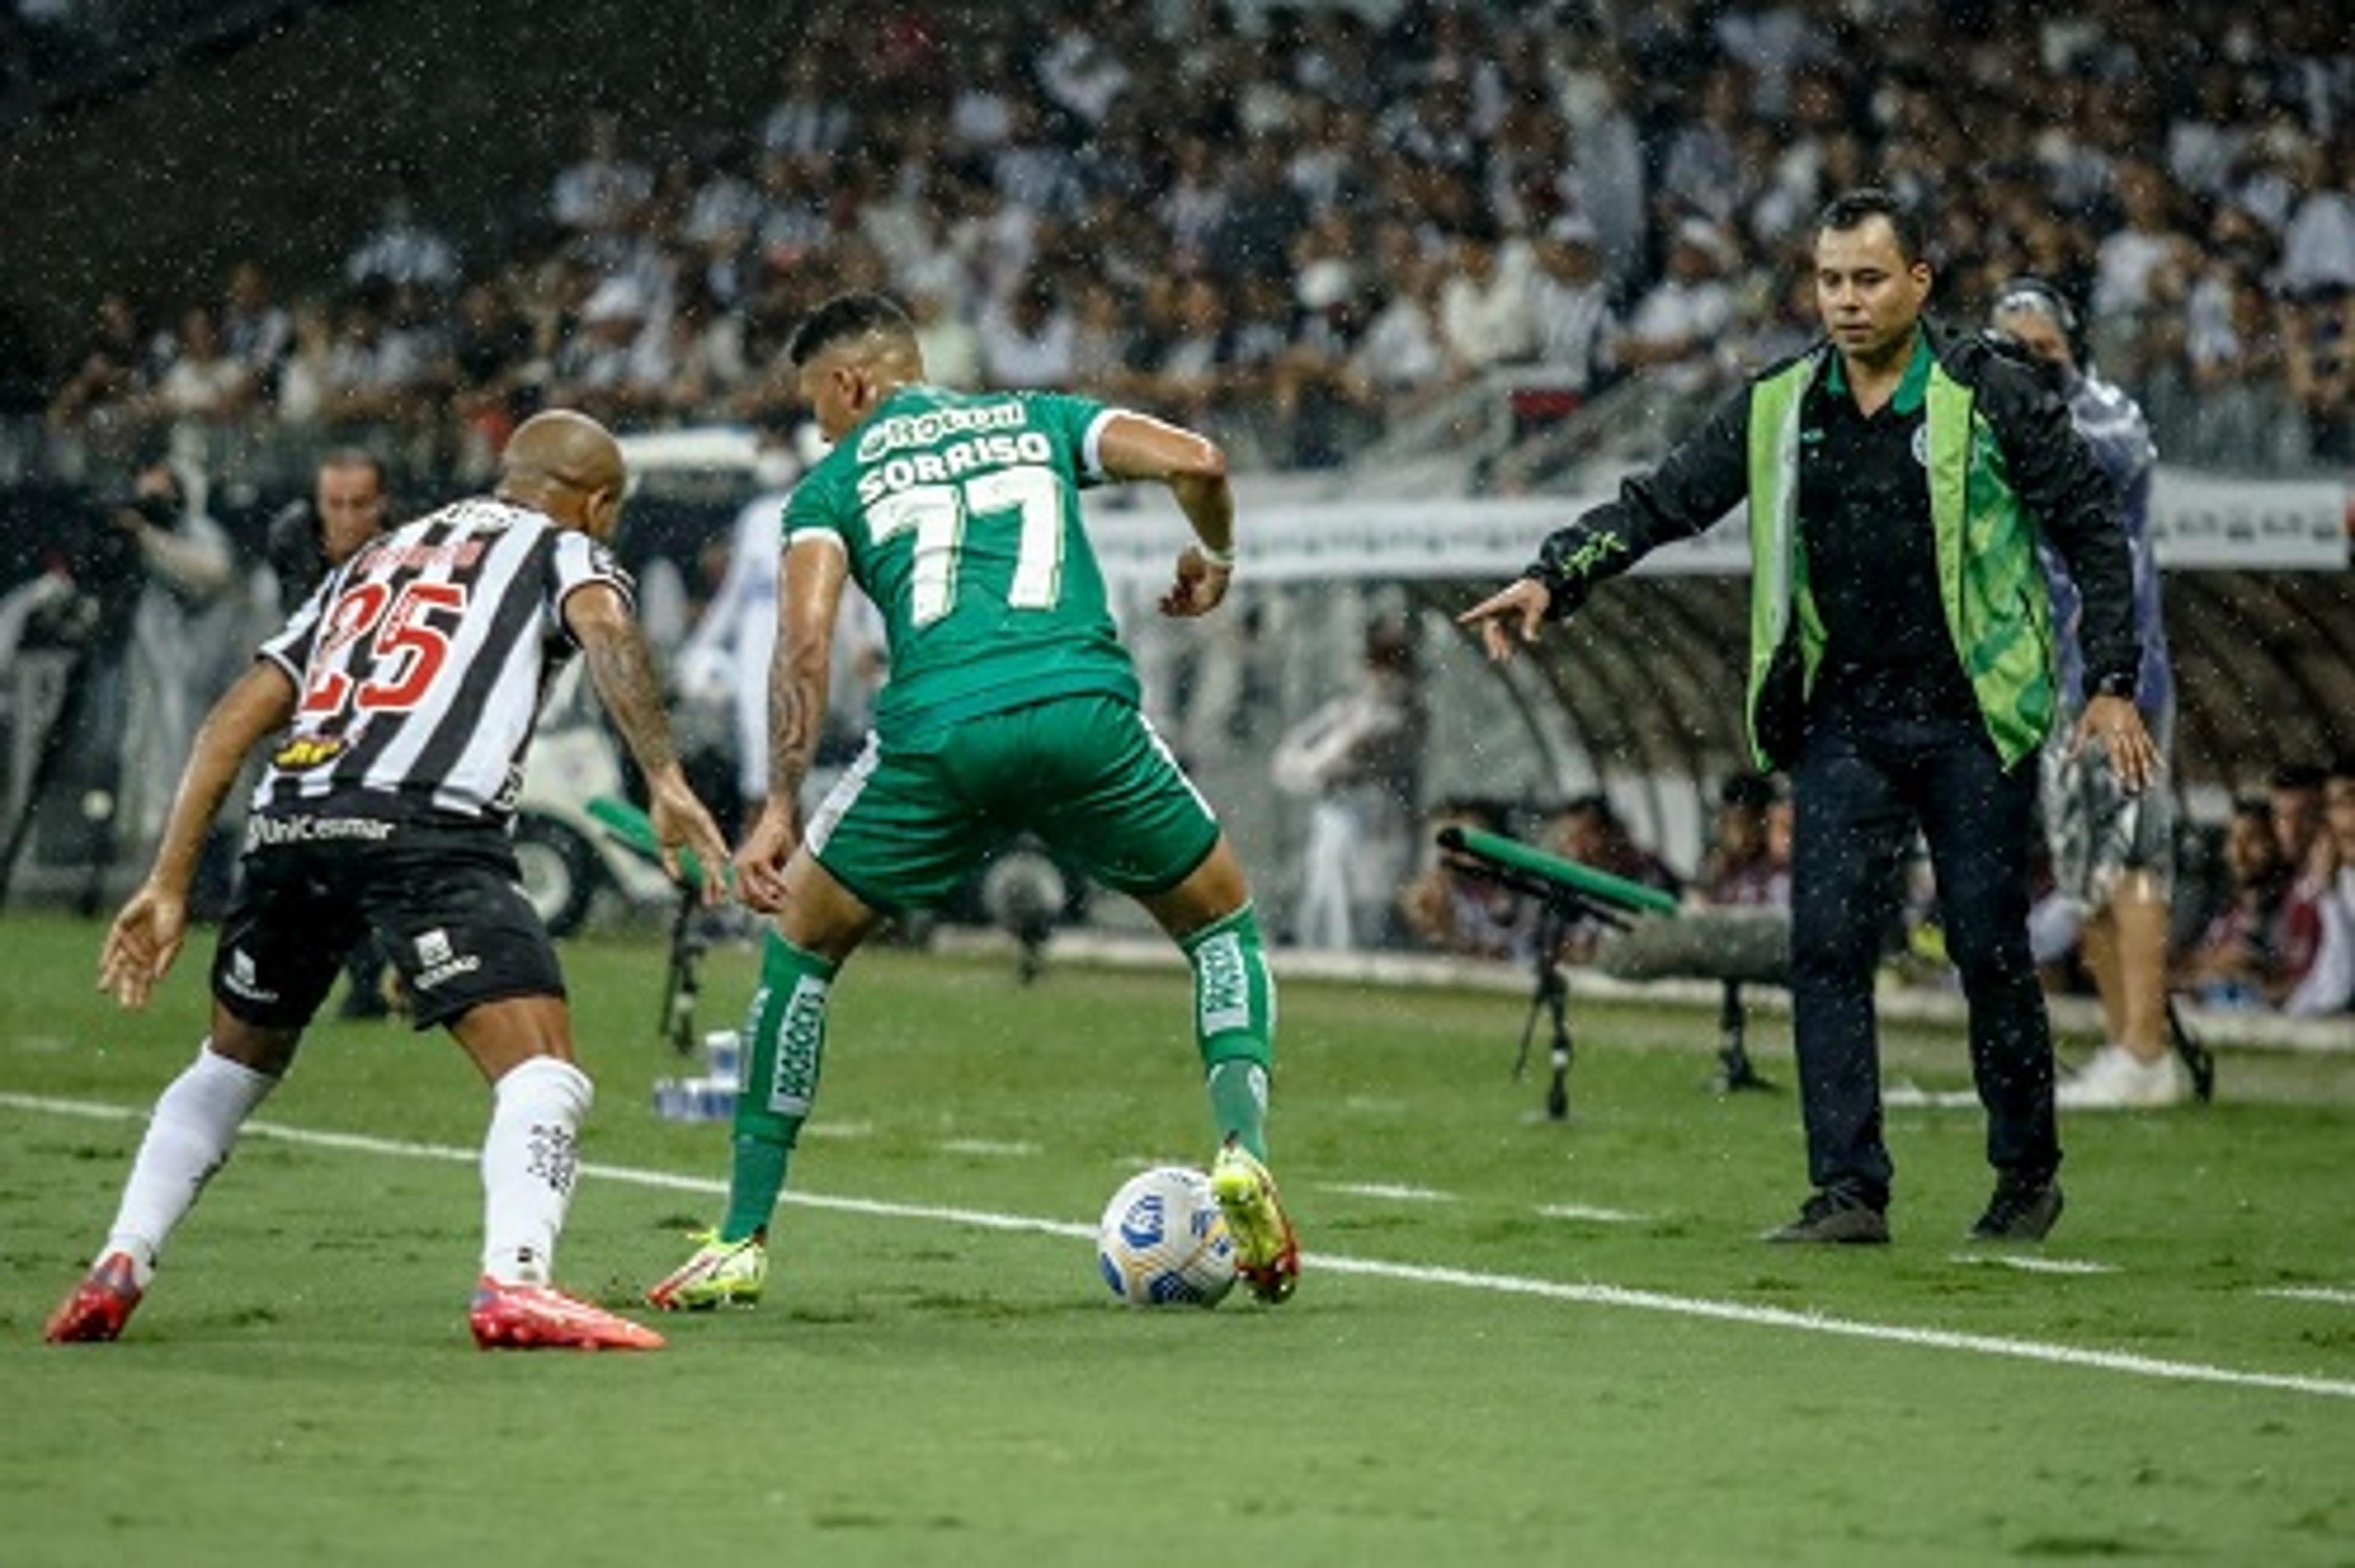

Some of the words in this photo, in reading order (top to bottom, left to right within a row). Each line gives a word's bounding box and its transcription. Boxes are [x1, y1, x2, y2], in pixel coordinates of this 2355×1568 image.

[857, 432, 1051, 503] SORRISO
[865, 464, 1066, 629] 77
[301, 581, 466, 713] 25
